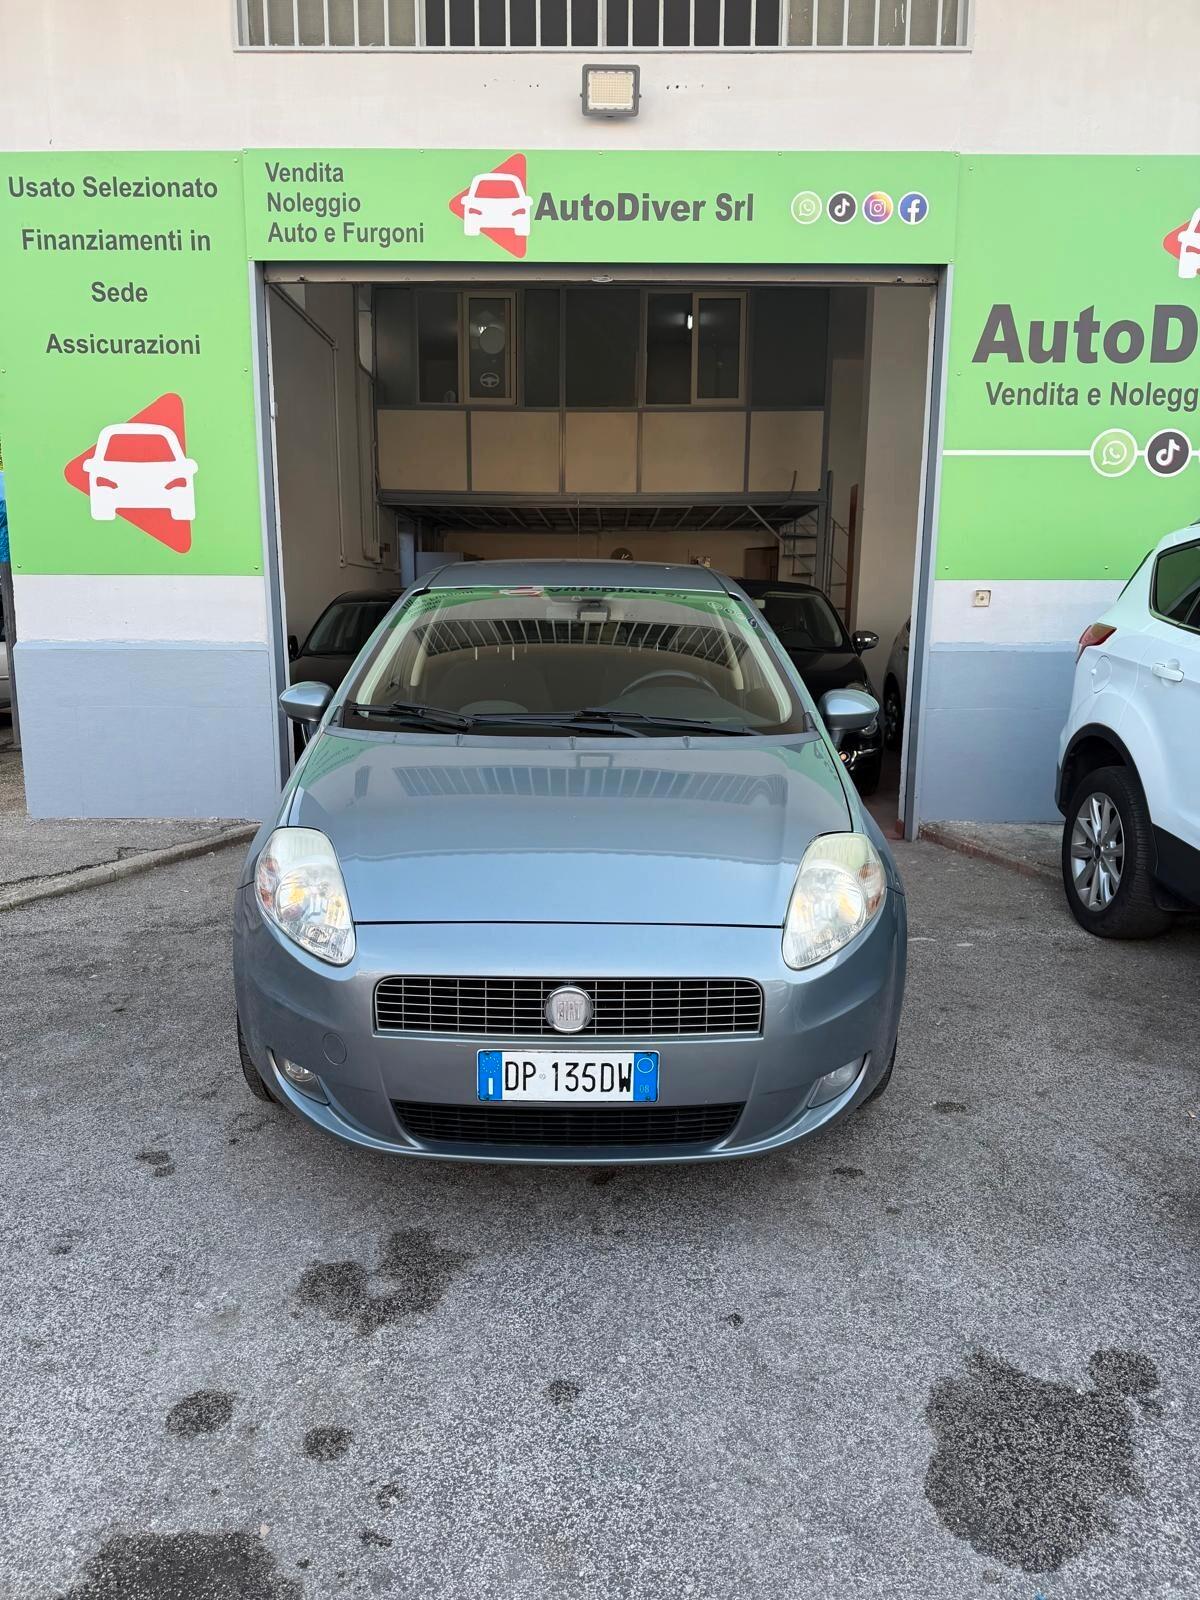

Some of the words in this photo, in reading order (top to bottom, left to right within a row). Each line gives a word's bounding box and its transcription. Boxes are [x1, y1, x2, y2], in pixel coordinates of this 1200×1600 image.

[265, 162, 344, 183] Vendita
[8, 176, 75, 198] Usato
[82, 176, 218, 199] Selezionato
[267, 192, 361, 218] Noleggio
[534, 192, 707, 222] AutoDiver
[715, 192, 754, 222] Srl
[21, 228, 183, 251] Finanziamenti
[190, 229, 211, 251] in
[268, 222, 318, 243] Auto
[324, 226, 336, 243] e
[343, 222, 424, 248] Furgoni
[91, 281, 148, 303] Sede
[46, 333, 201, 356] Assicurazioni
[971, 303, 1199, 364] AutoD
[985, 381, 1079, 406] Vendita
[1087, 387, 1101, 406] e
[504, 1061, 537, 1092] DP
[551, 1062, 633, 1093] 135DW
